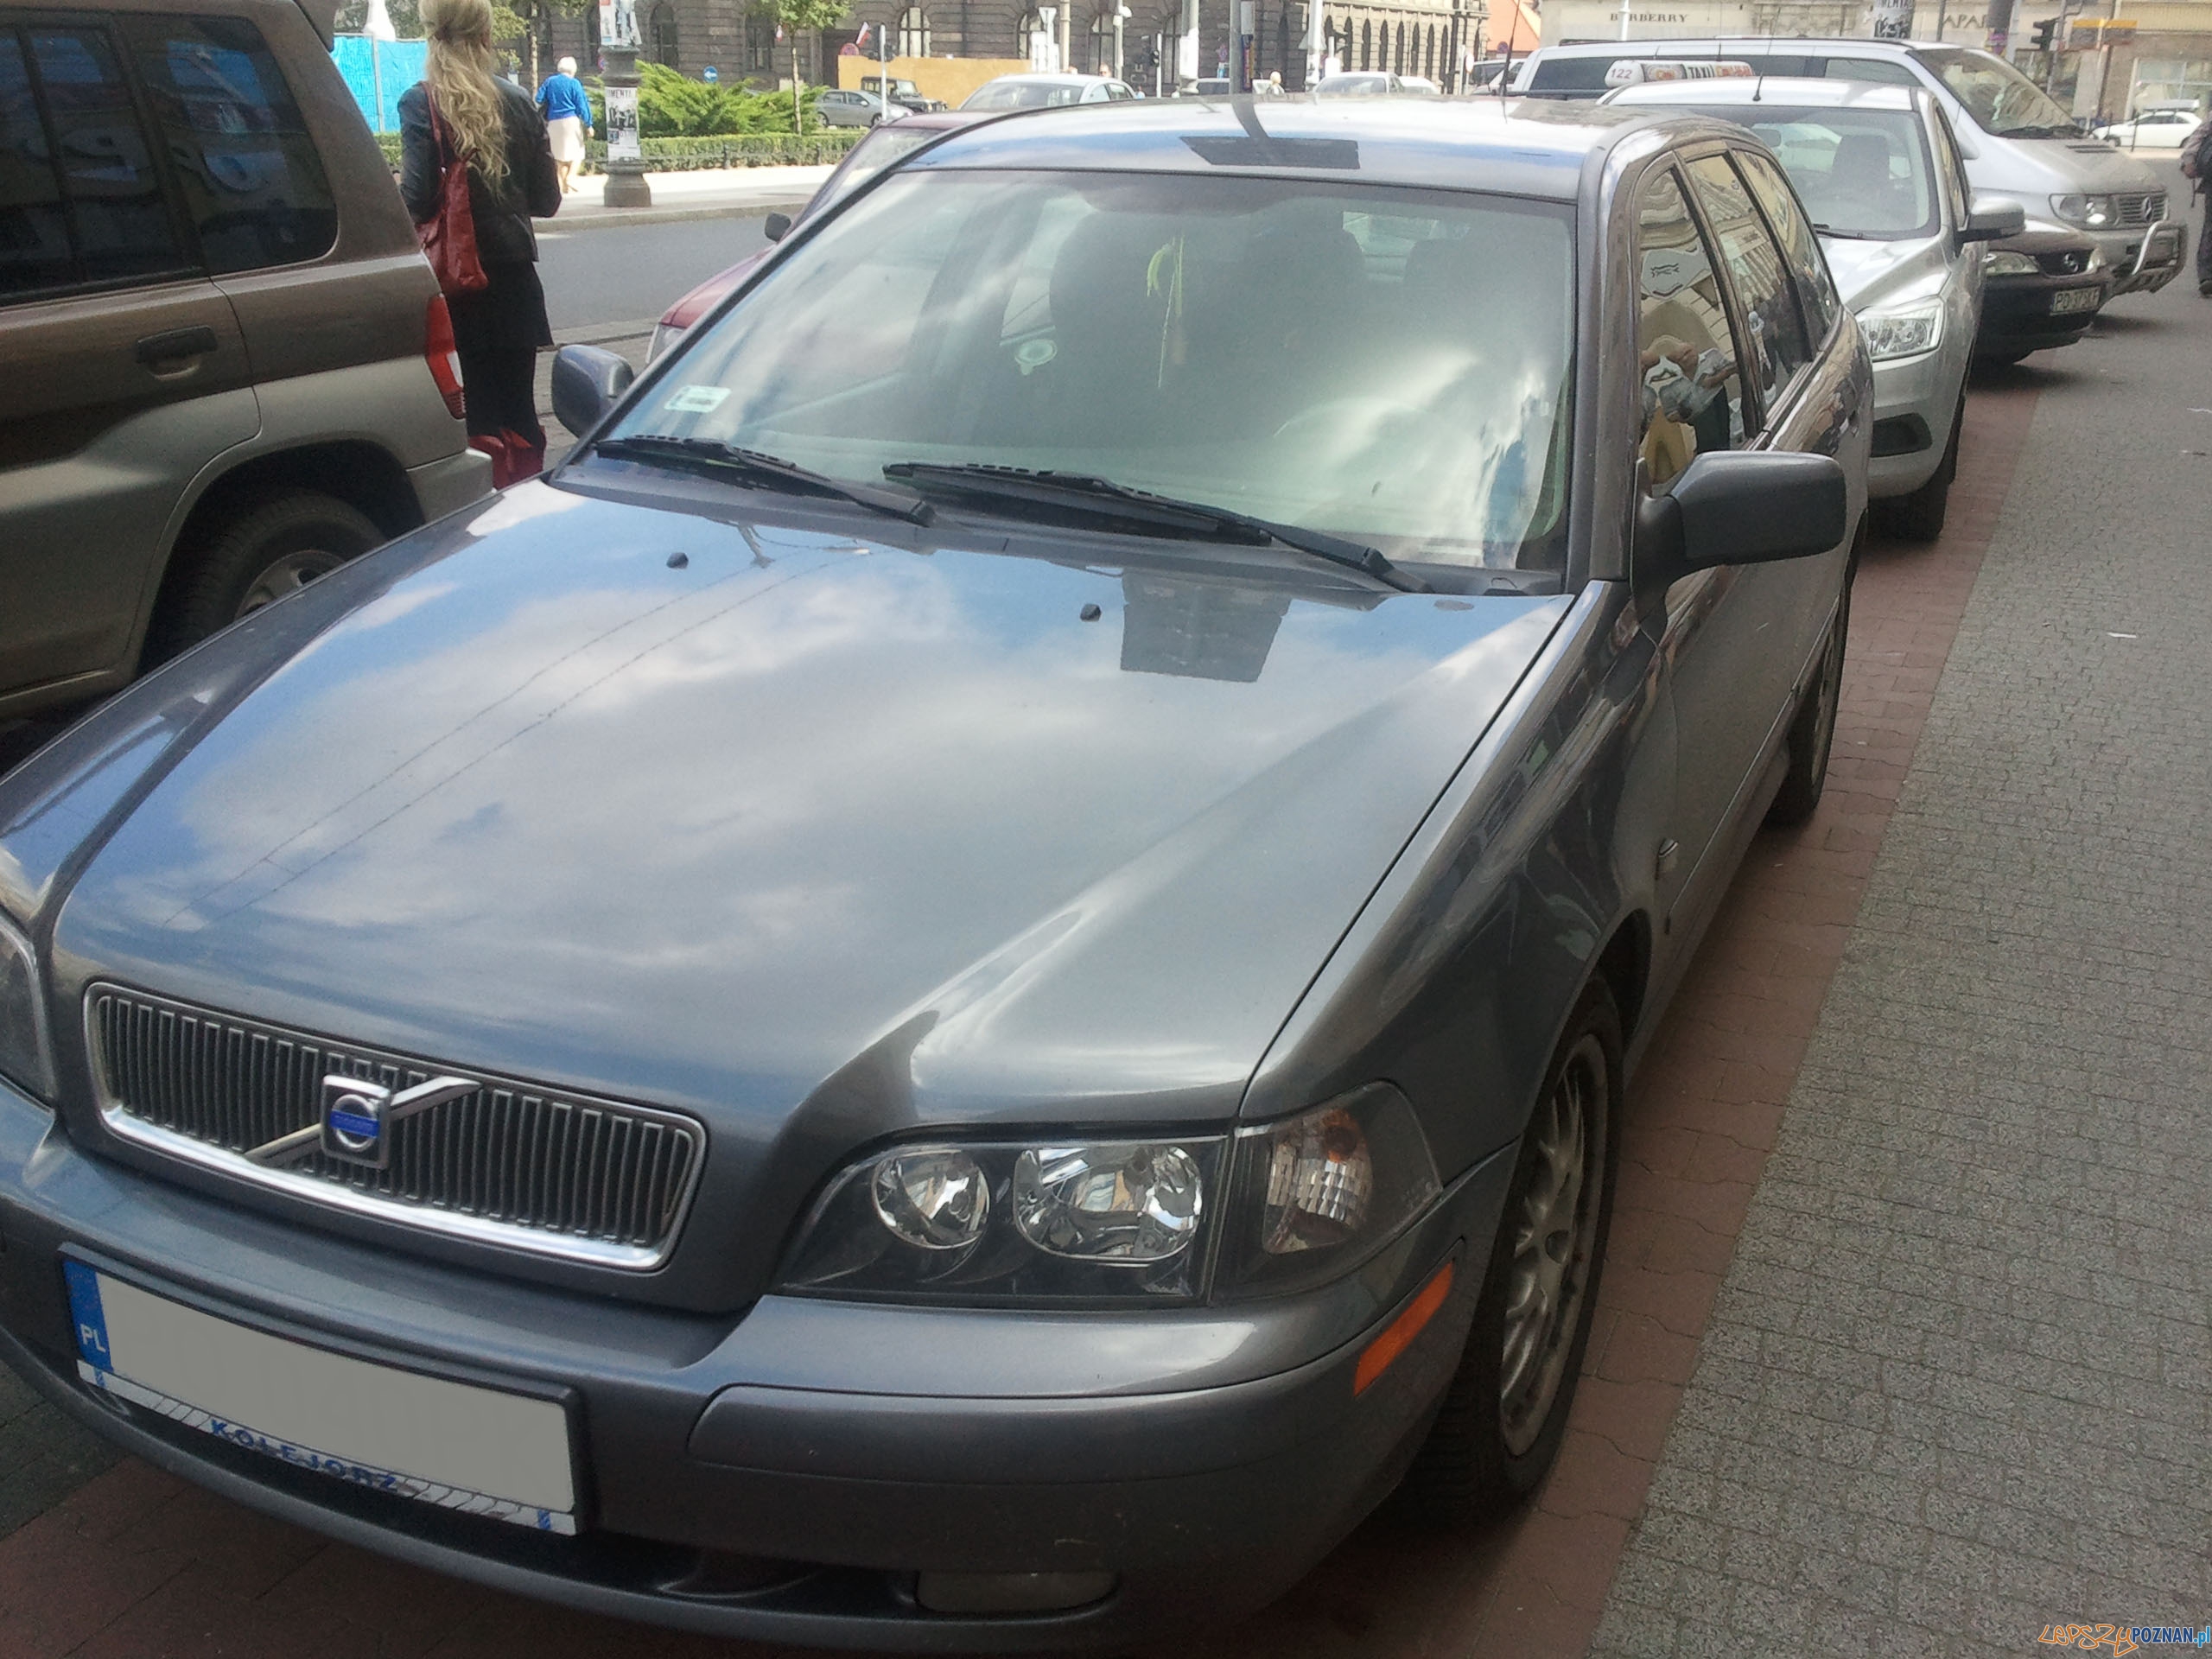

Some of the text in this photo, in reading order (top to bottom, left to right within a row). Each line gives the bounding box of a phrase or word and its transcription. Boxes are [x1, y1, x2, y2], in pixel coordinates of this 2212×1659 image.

[1611, 13, 1688, 22] BRBERRY
[1611, 68, 1633, 79] 122
[1688, 66, 1710, 79] TAXI
[79, 1323, 106, 1353] PL
[211, 1419, 397, 1492] KOLEJORZ
